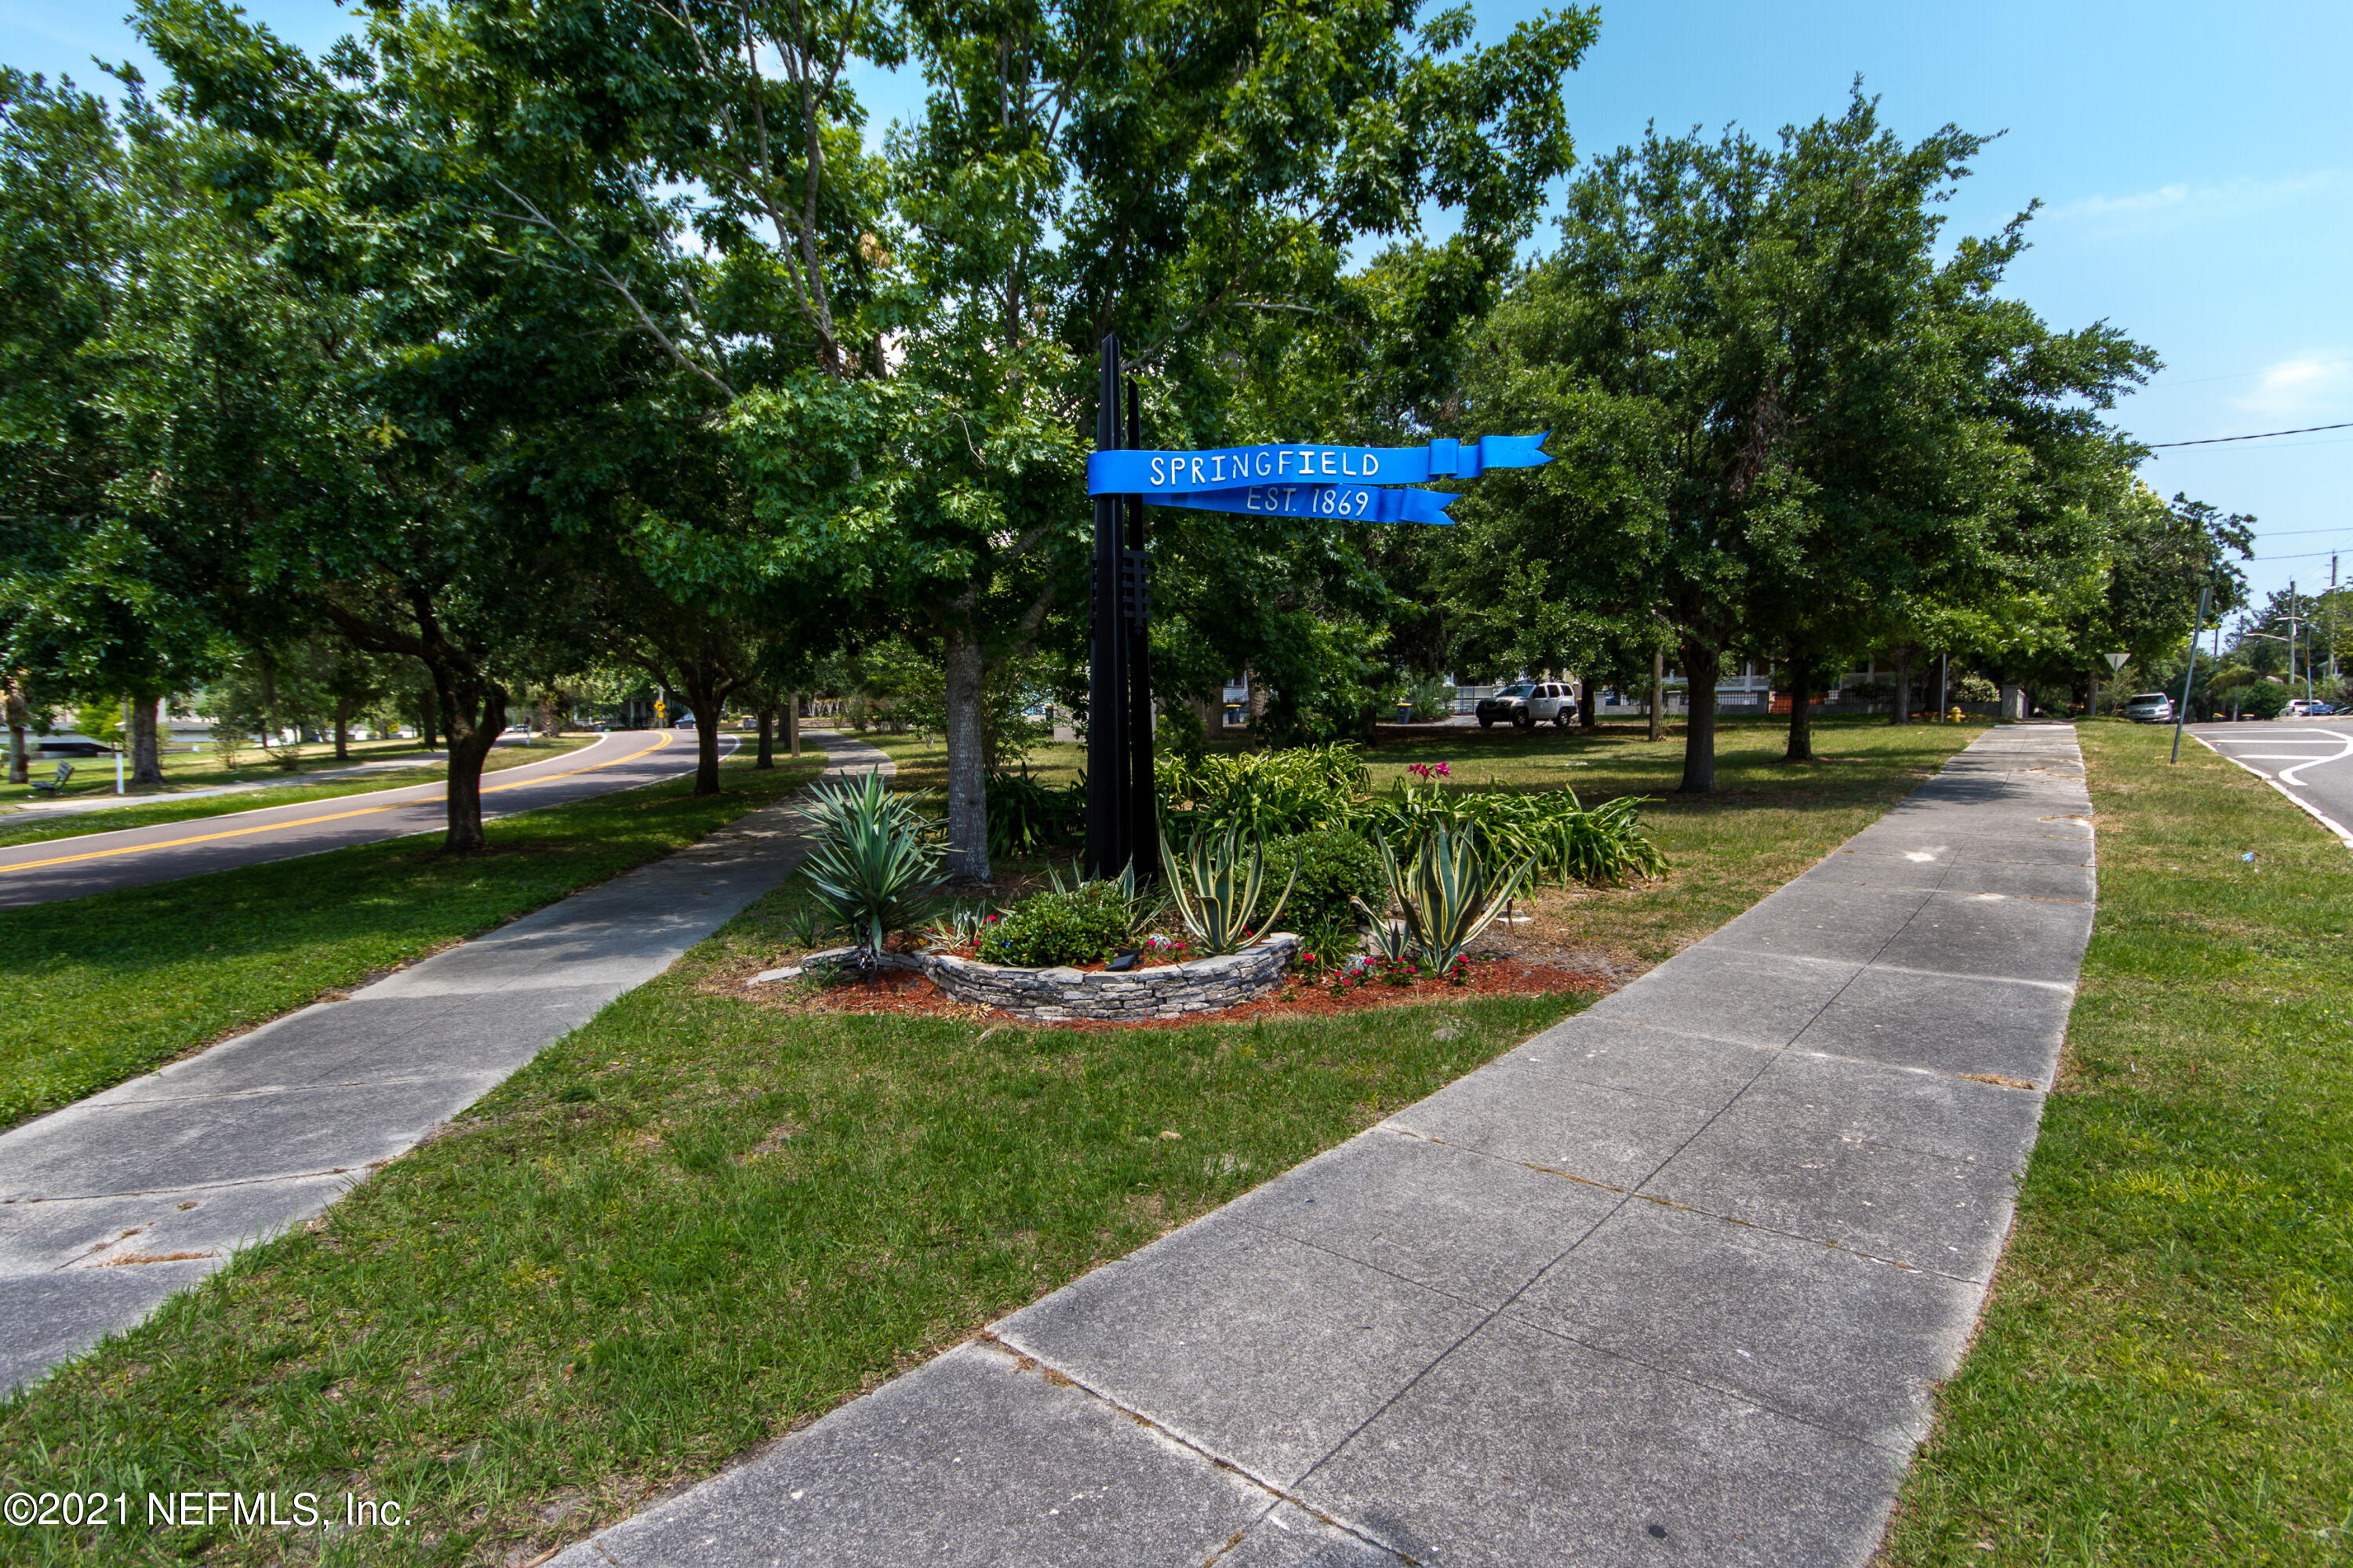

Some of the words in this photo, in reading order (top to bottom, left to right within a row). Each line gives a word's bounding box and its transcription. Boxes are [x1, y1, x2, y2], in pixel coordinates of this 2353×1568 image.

[1151, 451, 1380, 486] SPRINGFIELD
[1246, 486, 1297, 512] EST.
[1312, 489, 1369, 516] 1869
